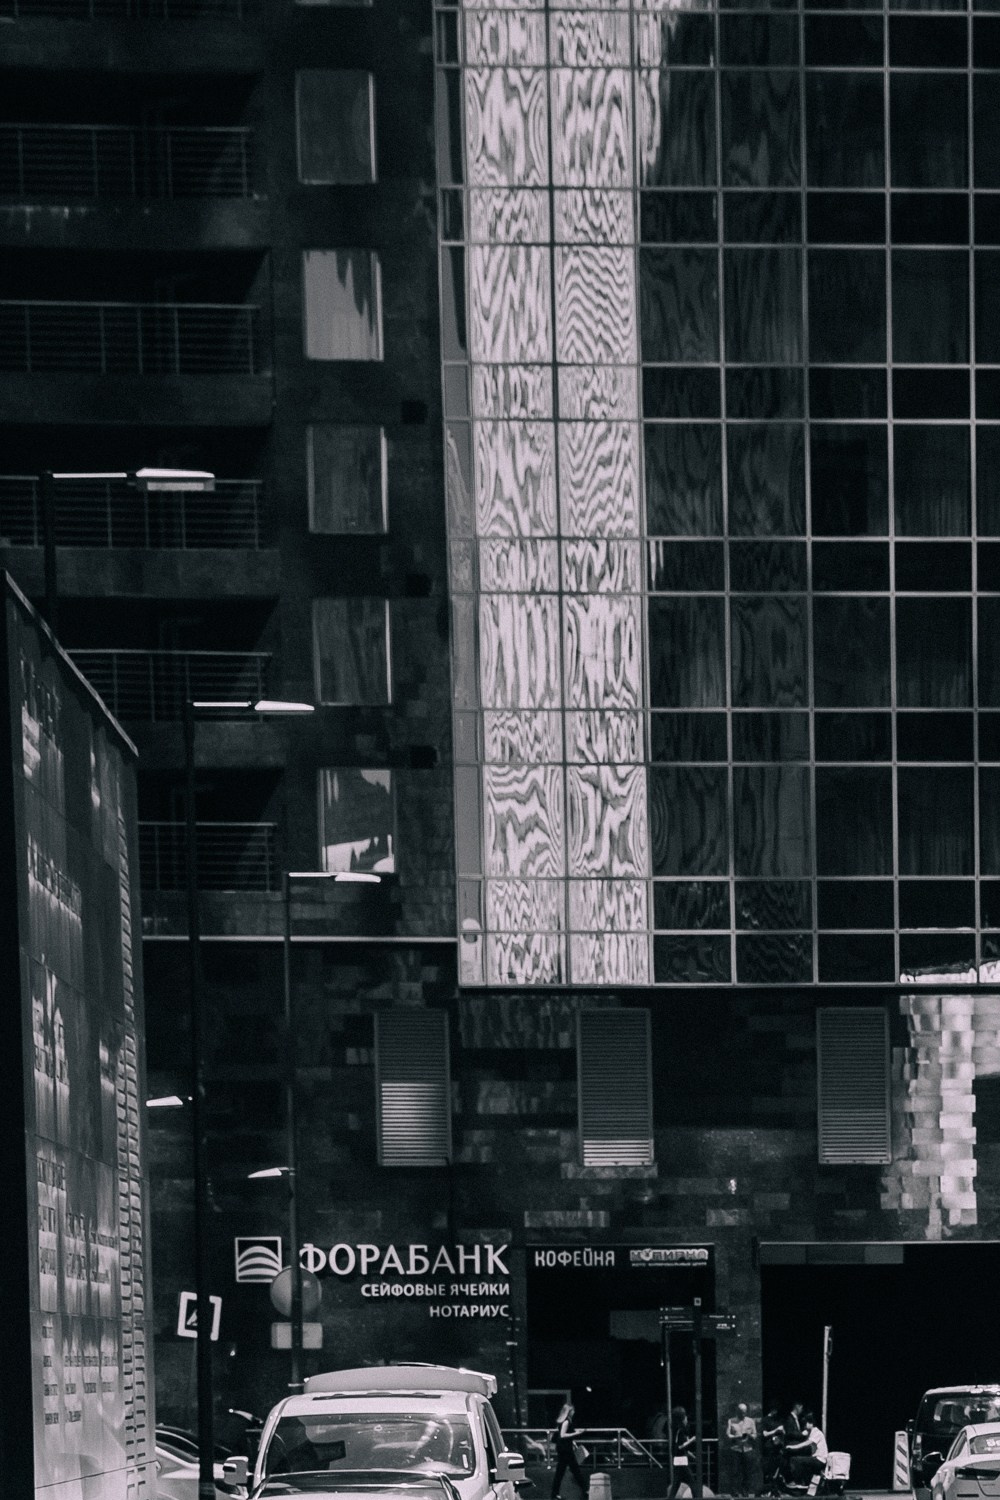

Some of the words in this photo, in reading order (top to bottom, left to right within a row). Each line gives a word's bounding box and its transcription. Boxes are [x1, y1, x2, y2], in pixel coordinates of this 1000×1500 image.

[299, 1243, 510, 1276] ФОРАБАНК
[535, 1248, 615, 1267] КОФЕЙНЯ
[361, 1283, 446, 1297] СЕЙФОВЫЕ
[450, 1283, 510, 1296] ЯЧЕЙКИ
[430, 1305, 510, 1318] НОТАРИУС
